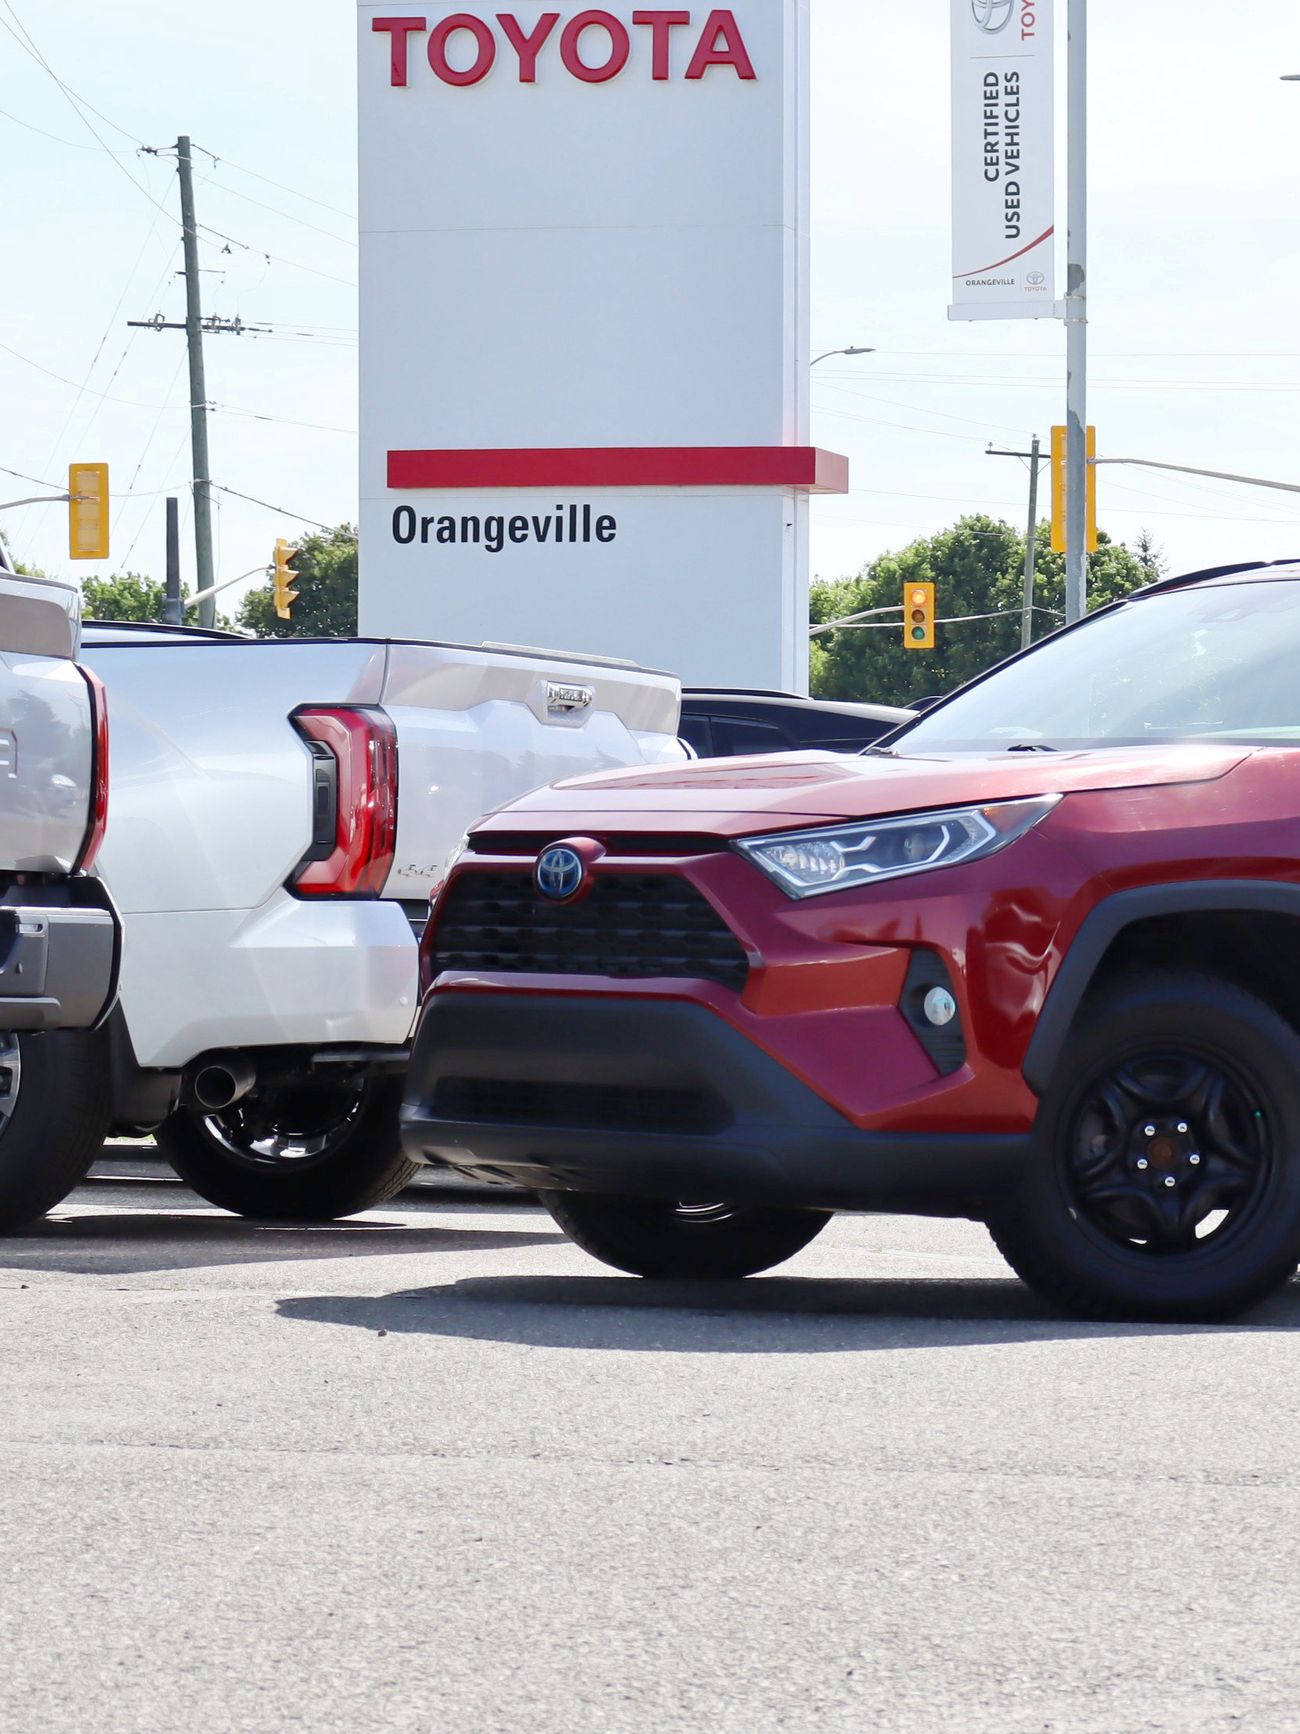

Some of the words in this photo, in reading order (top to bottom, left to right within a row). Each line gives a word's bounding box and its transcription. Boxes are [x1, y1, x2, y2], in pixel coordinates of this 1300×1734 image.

[372, 9, 757, 88] TOYOTA
[983, 72, 1000, 182] CERTIFIED
[1004, 71, 1021, 177] VEHICLES
[1004, 181, 1021, 239] USED
[965, 278, 1015, 287] ORANGEVILLE
[392, 504, 617, 553] Orangeville
